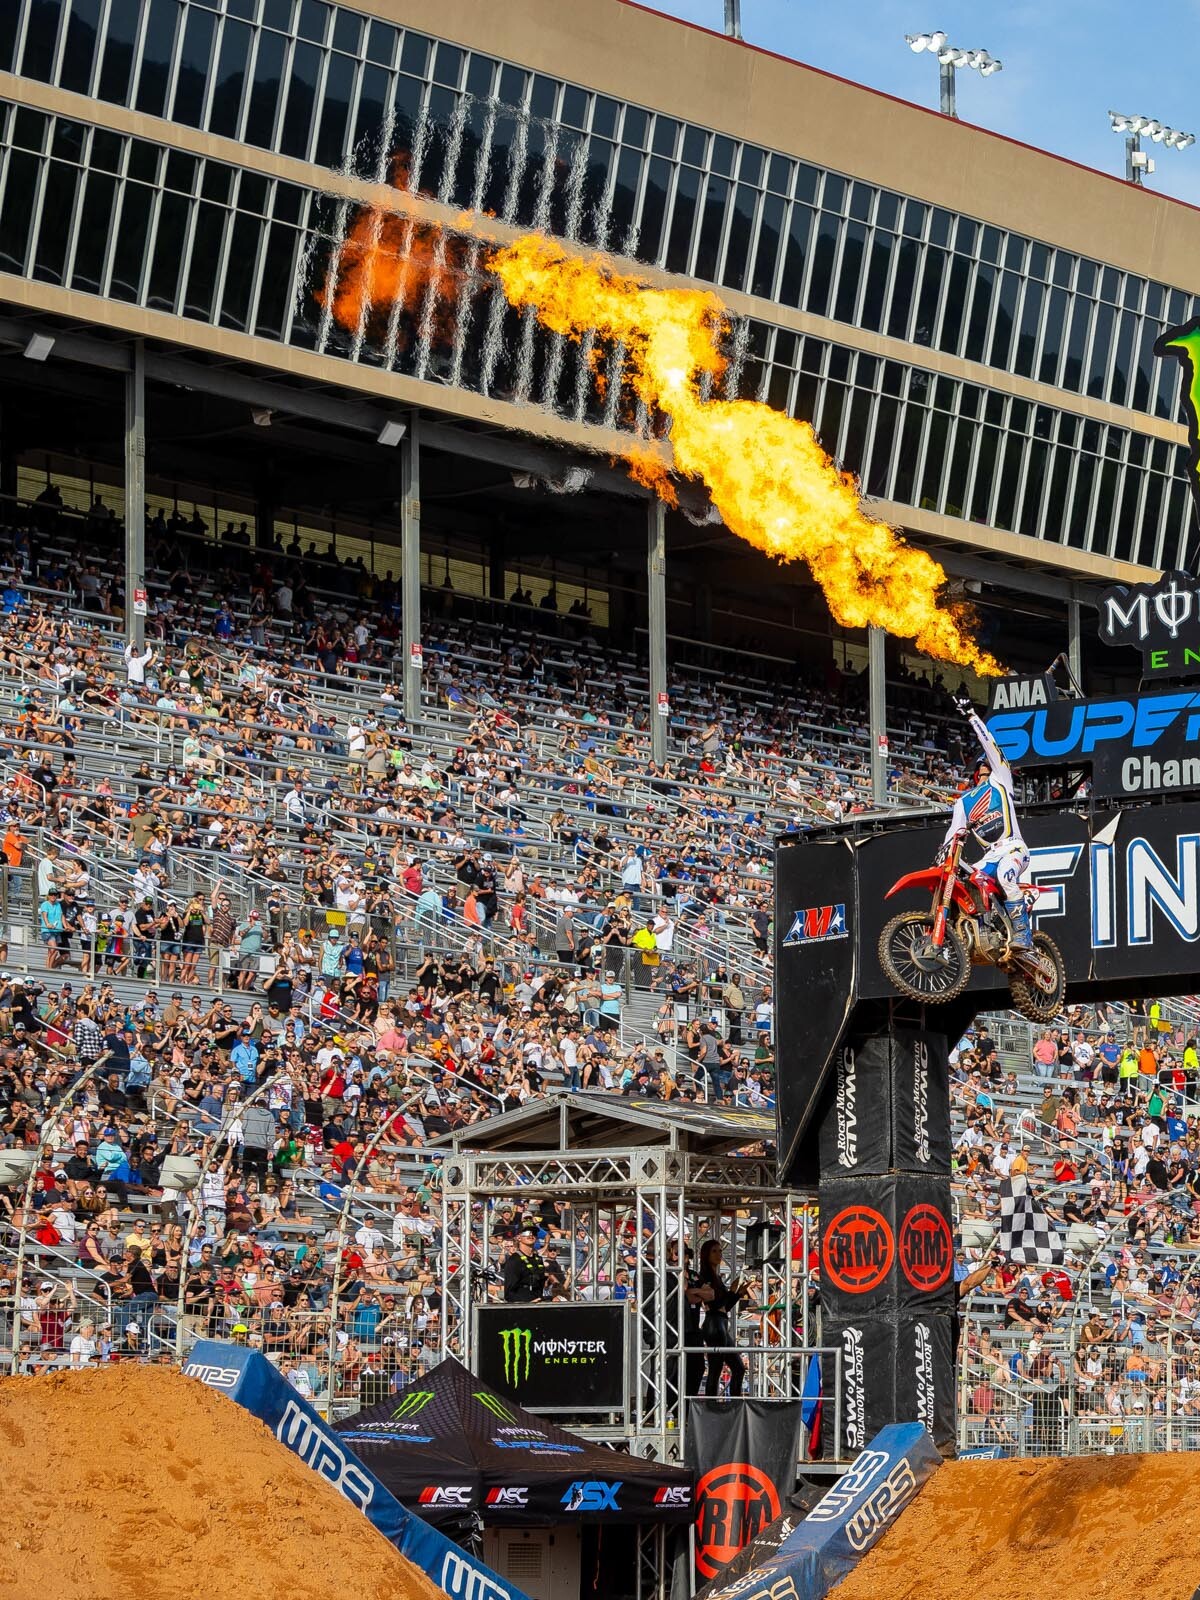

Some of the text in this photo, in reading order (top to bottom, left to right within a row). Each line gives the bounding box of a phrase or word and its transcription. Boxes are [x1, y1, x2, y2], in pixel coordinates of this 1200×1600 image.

[993, 679, 1047, 709] AMA
[782, 904, 849, 942] AMA
[913, 1041, 922, 1143] ROCKY MOUNTAIN
[837, 1111, 846, 1150] ROCKY
[834, 1230, 881, 1268] RM
[909, 1230, 942, 1268] RM
[533, 1338, 607, 1356] MONSTER
[544, 1357, 596, 1365] ENERGY
[924, 1342, 932, 1382] ROCKY
[855, 1345, 865, 1448] ROCKY MOUNTAIN
[430, 1486, 472, 1503] ASC
[490, 1487, 528, 1503] ASC
